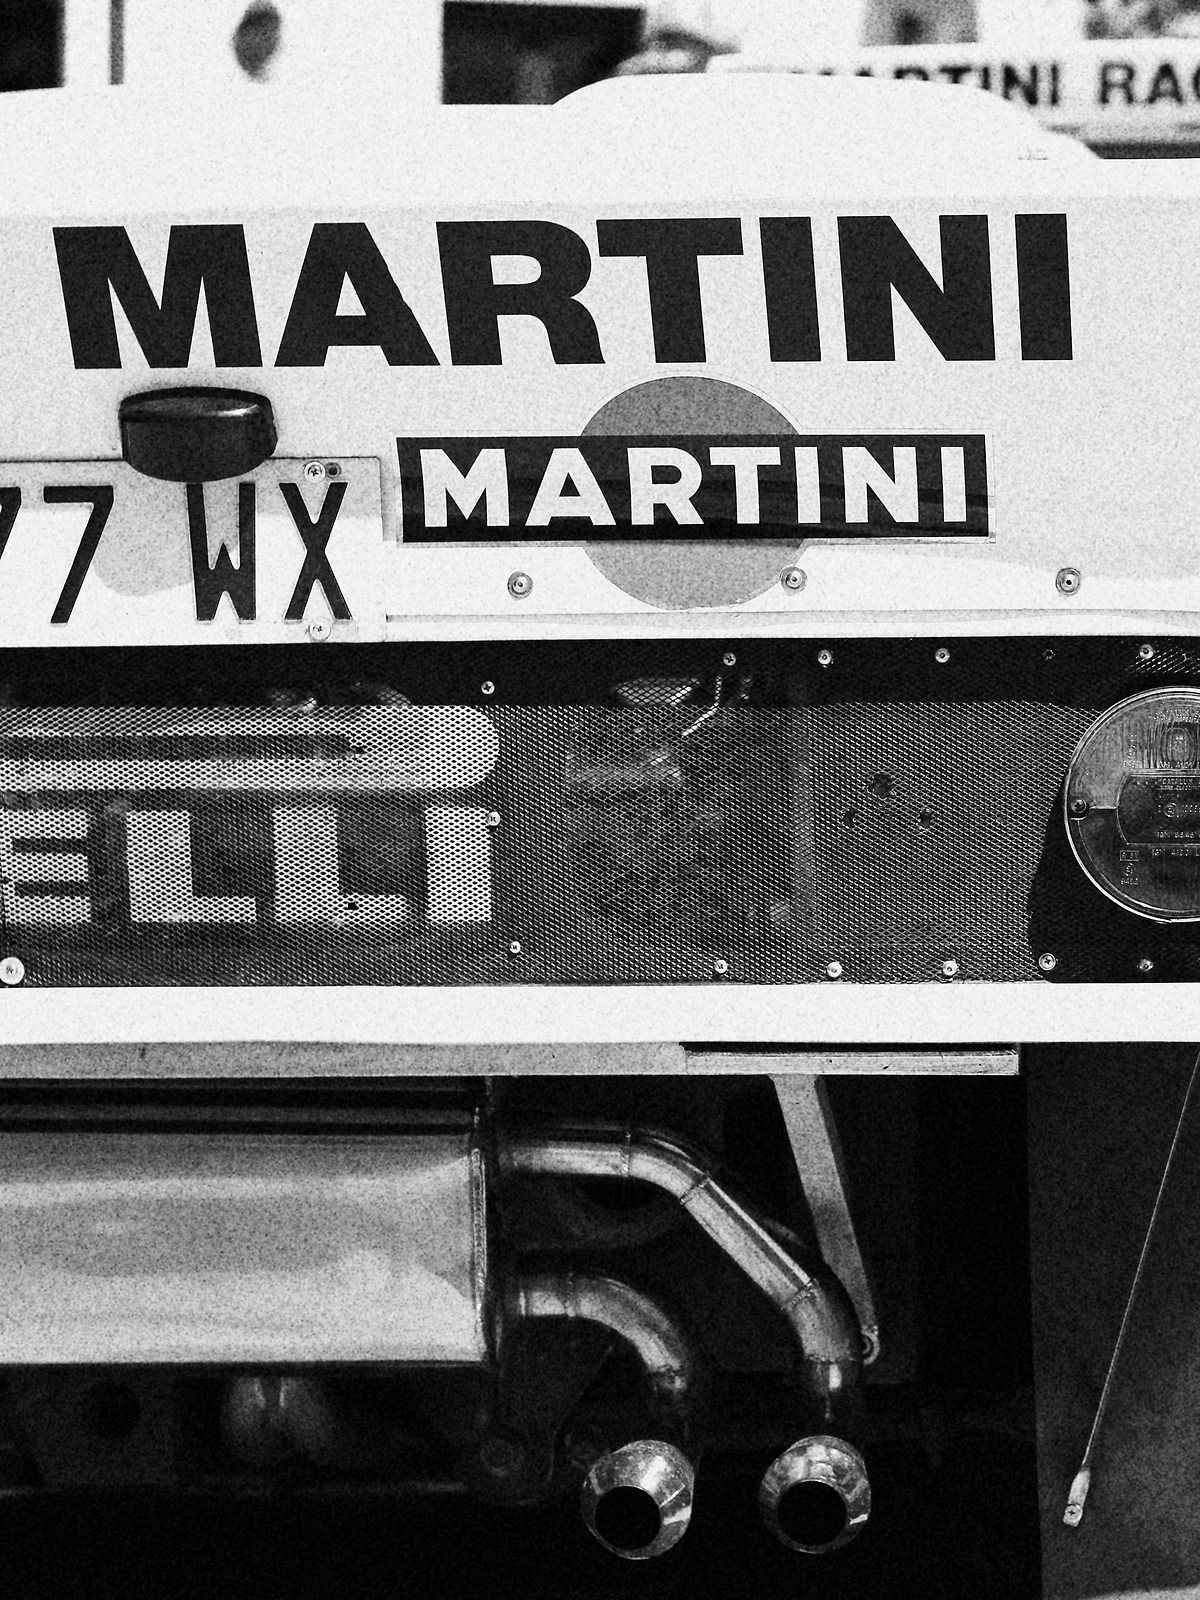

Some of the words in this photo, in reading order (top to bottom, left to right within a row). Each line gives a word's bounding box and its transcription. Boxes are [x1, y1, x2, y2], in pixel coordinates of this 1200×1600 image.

[52, 213, 1073, 369] MARTINI
[186, 481, 353, 622] WX
[418, 446, 968, 528] MARTINI
